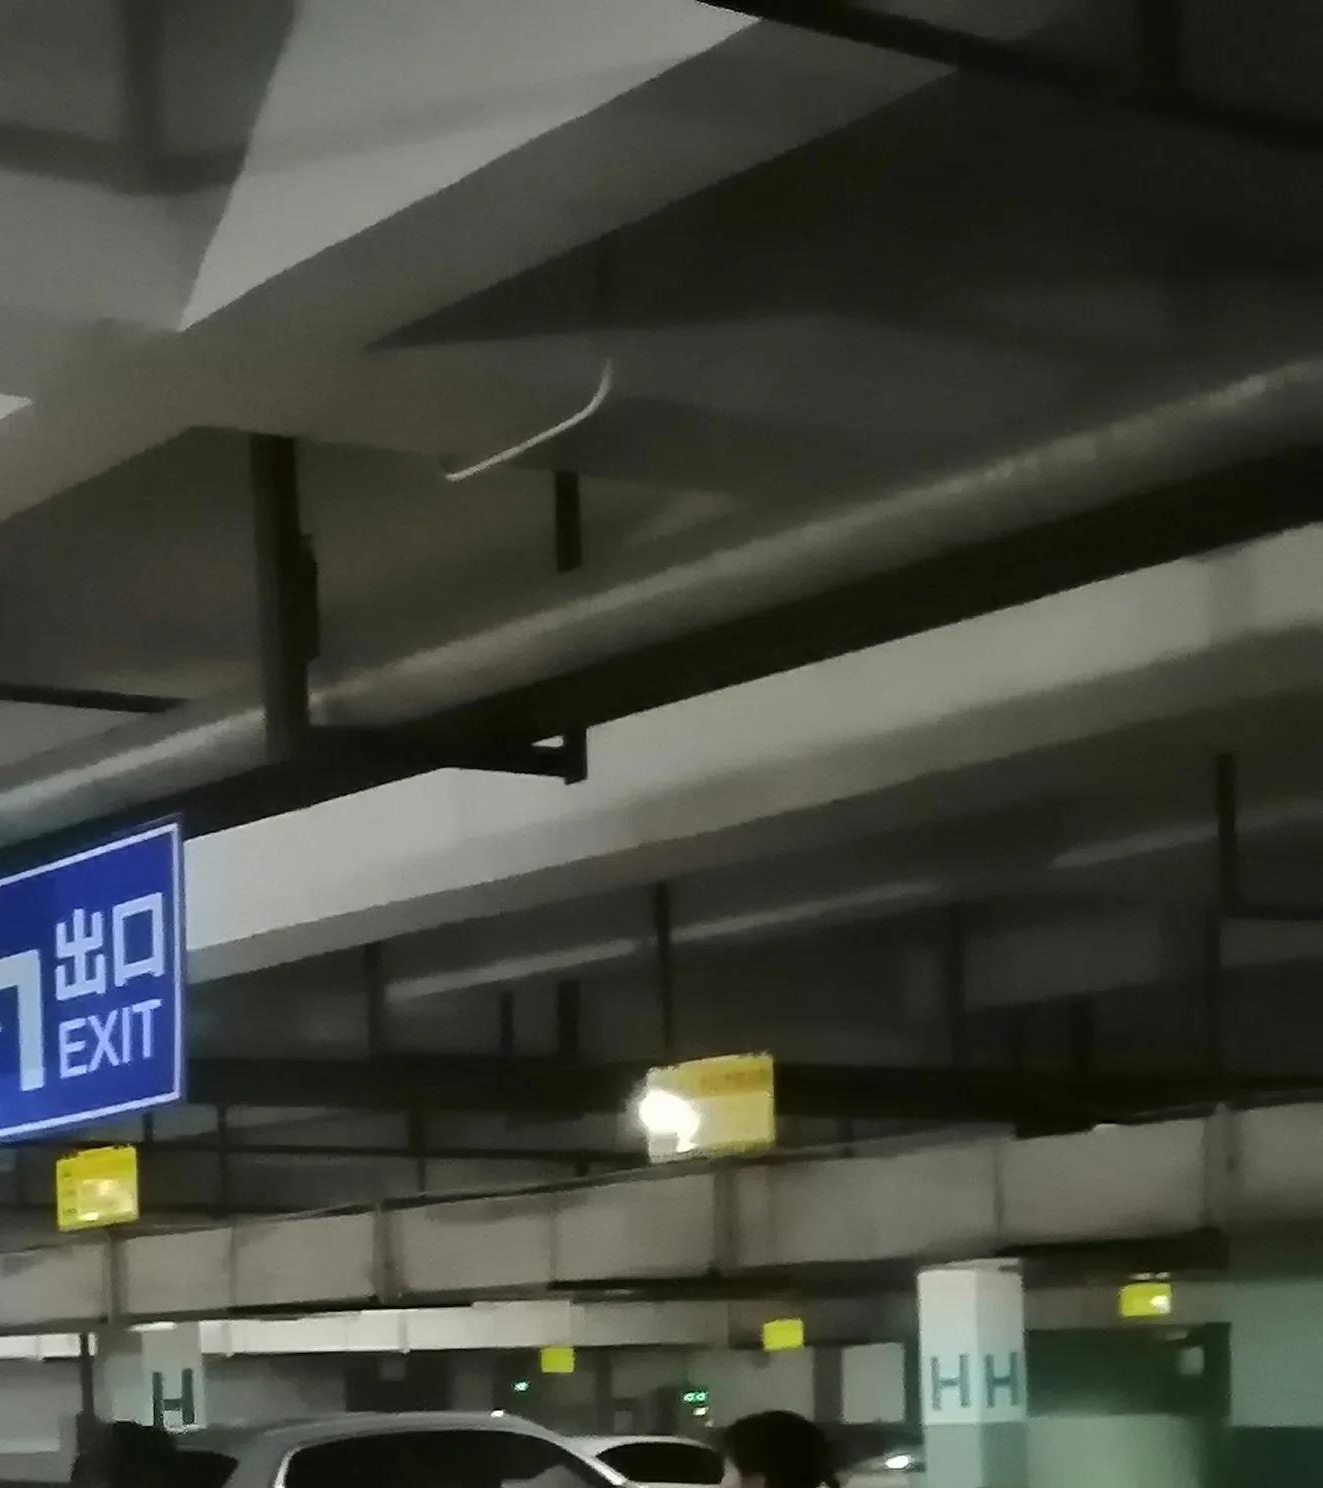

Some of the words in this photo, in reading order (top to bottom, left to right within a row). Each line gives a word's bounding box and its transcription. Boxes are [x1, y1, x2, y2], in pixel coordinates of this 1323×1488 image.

[55, 892, 166, 1001] 出口
[59, 998, 163, 1080] EXIT
[152, 1367, 195, 1426] H
[931, 1353, 971, 1410] H
[984, 1351, 1019, 1408] H
